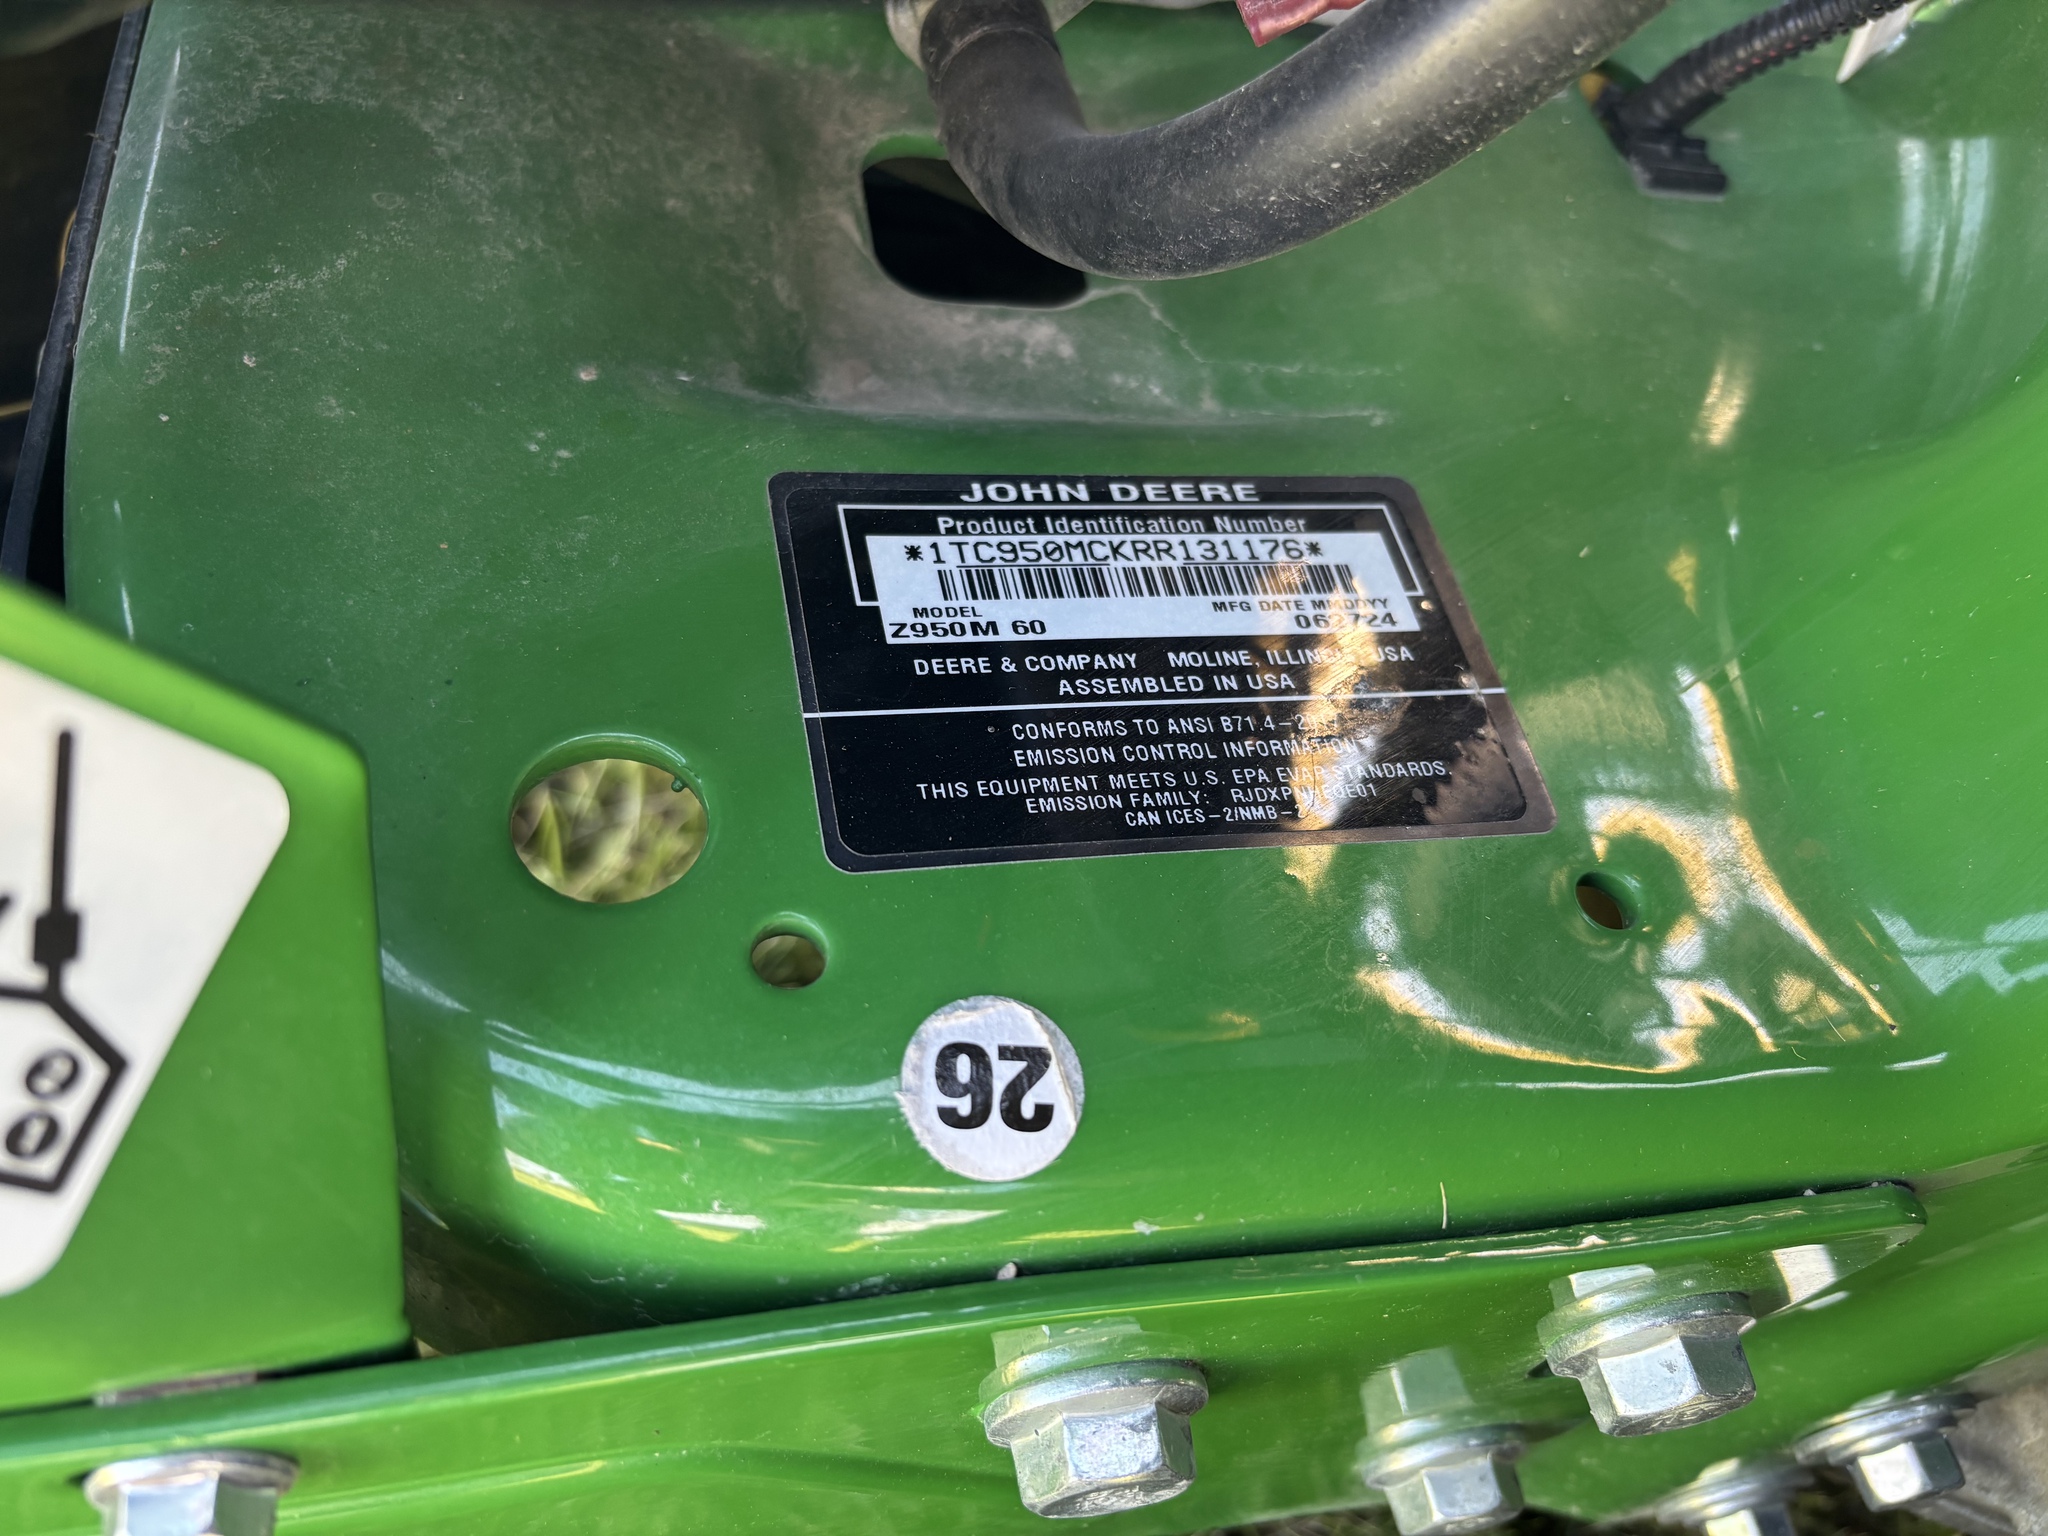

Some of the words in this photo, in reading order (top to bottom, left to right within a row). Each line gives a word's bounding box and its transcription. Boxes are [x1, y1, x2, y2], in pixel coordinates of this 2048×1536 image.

[959, 483, 1090, 502] JOHN
[1109, 483, 1260, 502] DEERE
[937, 516, 1036, 534] Product
[1045, 515, 1205, 534] Identification
[1213, 516, 1307, 533] Number
[912, 606, 983, 618] MODEL
[1212, 600, 1252, 612] MFG
[1259, 600, 1305, 612] DATE
[1310, 598, 1388, 611] MMDDYY
[889, 620, 1000, 638] Z950M
[1011, 619, 1047, 635] 60
[914, 656, 992, 676] DEERE
[1001, 657, 1018, 673] &
[1025, 653, 1137, 672] COMPANY
[1168, 650, 1261, 668] MOLINE,
[1266, 645, 1359, 665] ILLIN
[1058, 676, 1204, 696] ASSEMBLED
[1214, 675, 1238, 691] IN
[1247, 673, 1296, 690] USA
[1012, 720, 1128, 740] CONFORMS
[1132, 718, 1159, 736] TO
[1168, 715, 1215, 735] ANSI
[1014, 746, 1116, 768] EMISSION
[1122, 741, 1217, 762] CONTROL
[1223, 738, 1359, 758] INFORMATION
[916, 782, 969, 800] THIS
[977, 775, 1099, 797] EQUIPMENT
[1108, 772, 1178, 790] MEETS
[1184, 768, 1226, 786] U.S.
[1232, 768, 1270, 784] EPA
[1276, 766, 1325, 782] EVAP
[1332, 760, 1453, 779] STANDARDS.
[1026, 796, 1122, 814] EMISSION
[1130, 791, 1211, 808] FAMILY:
[1125, 810, 1160, 827] CAN
[935, 1041, 1054, 1132] 26
